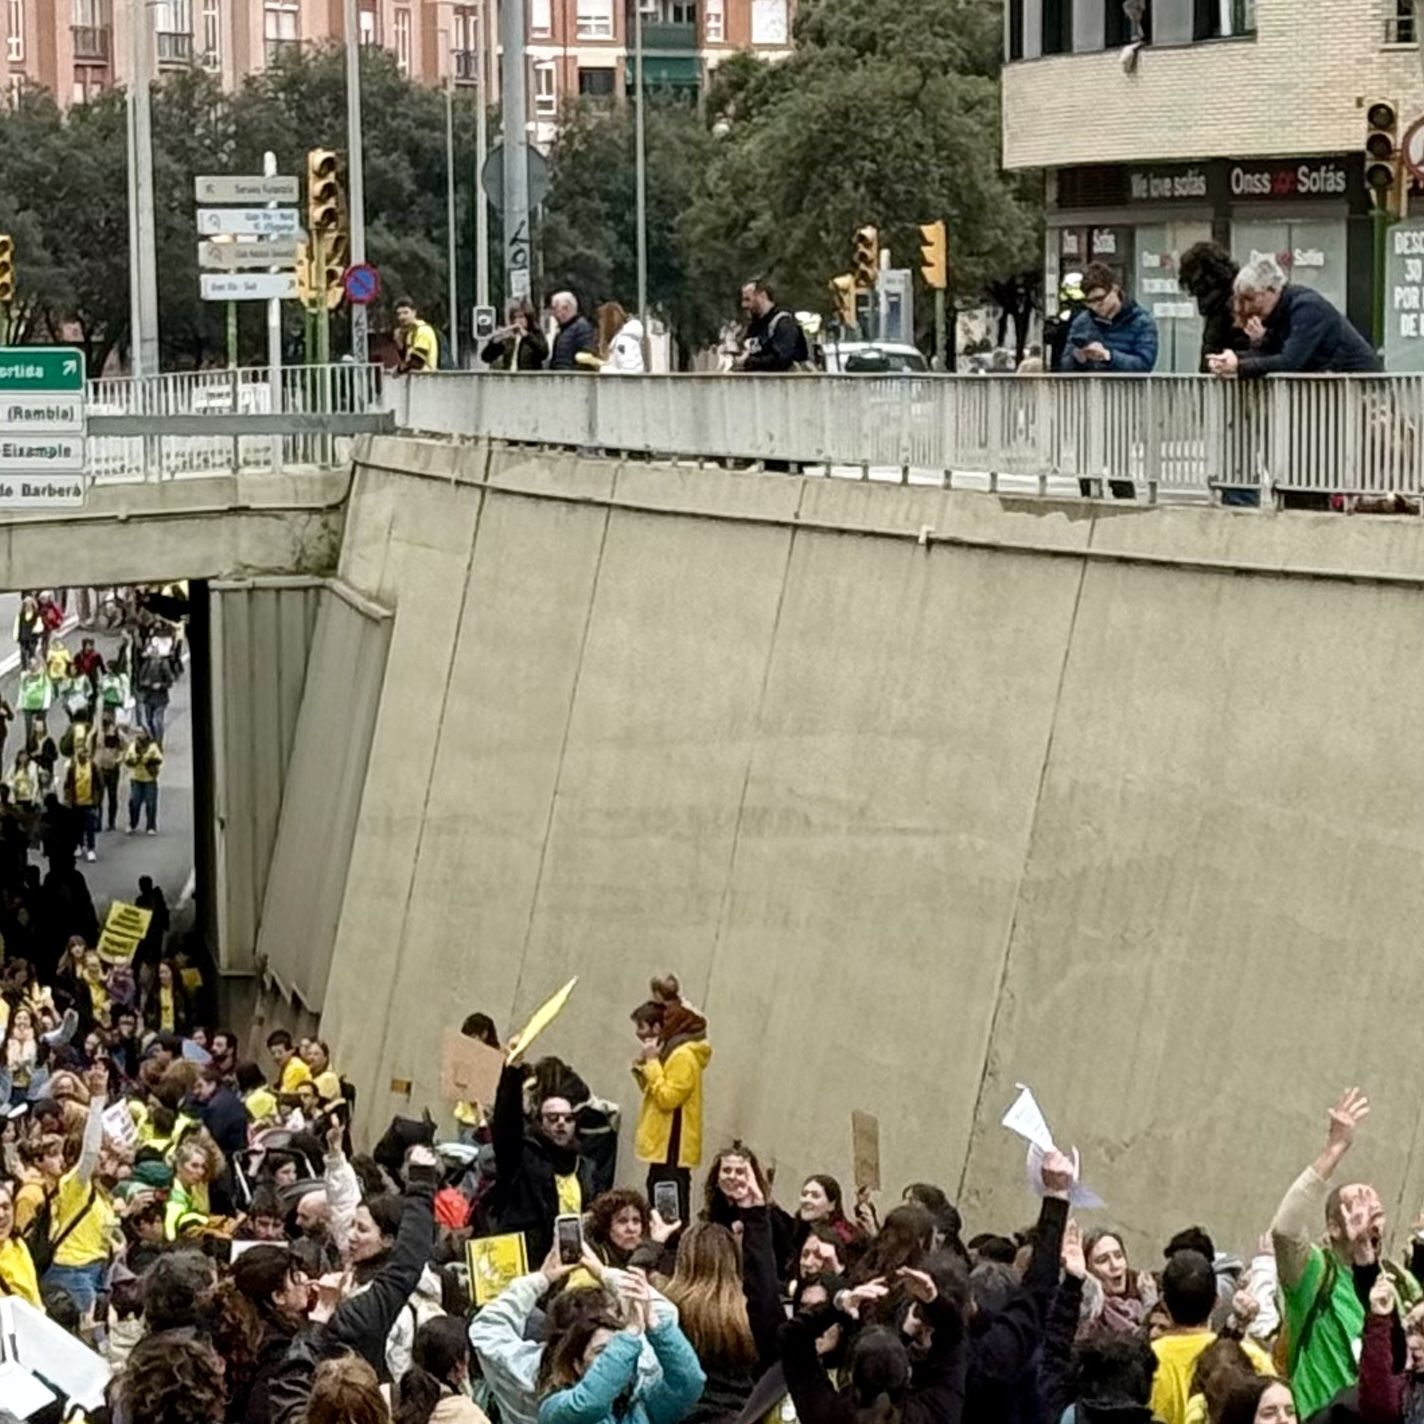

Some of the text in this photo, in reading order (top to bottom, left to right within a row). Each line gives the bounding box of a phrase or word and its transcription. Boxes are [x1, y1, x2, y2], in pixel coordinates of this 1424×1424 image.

[1149, 174, 1171, 197] love
[1231, 163, 1345, 195] Onss Sofás
[1394, 286, 1422, 310] POR
[1401, 313, 1419, 337] DE
[8, 405, 74, 422] (Rambla)
[22, 482, 82, 498] Barberà
